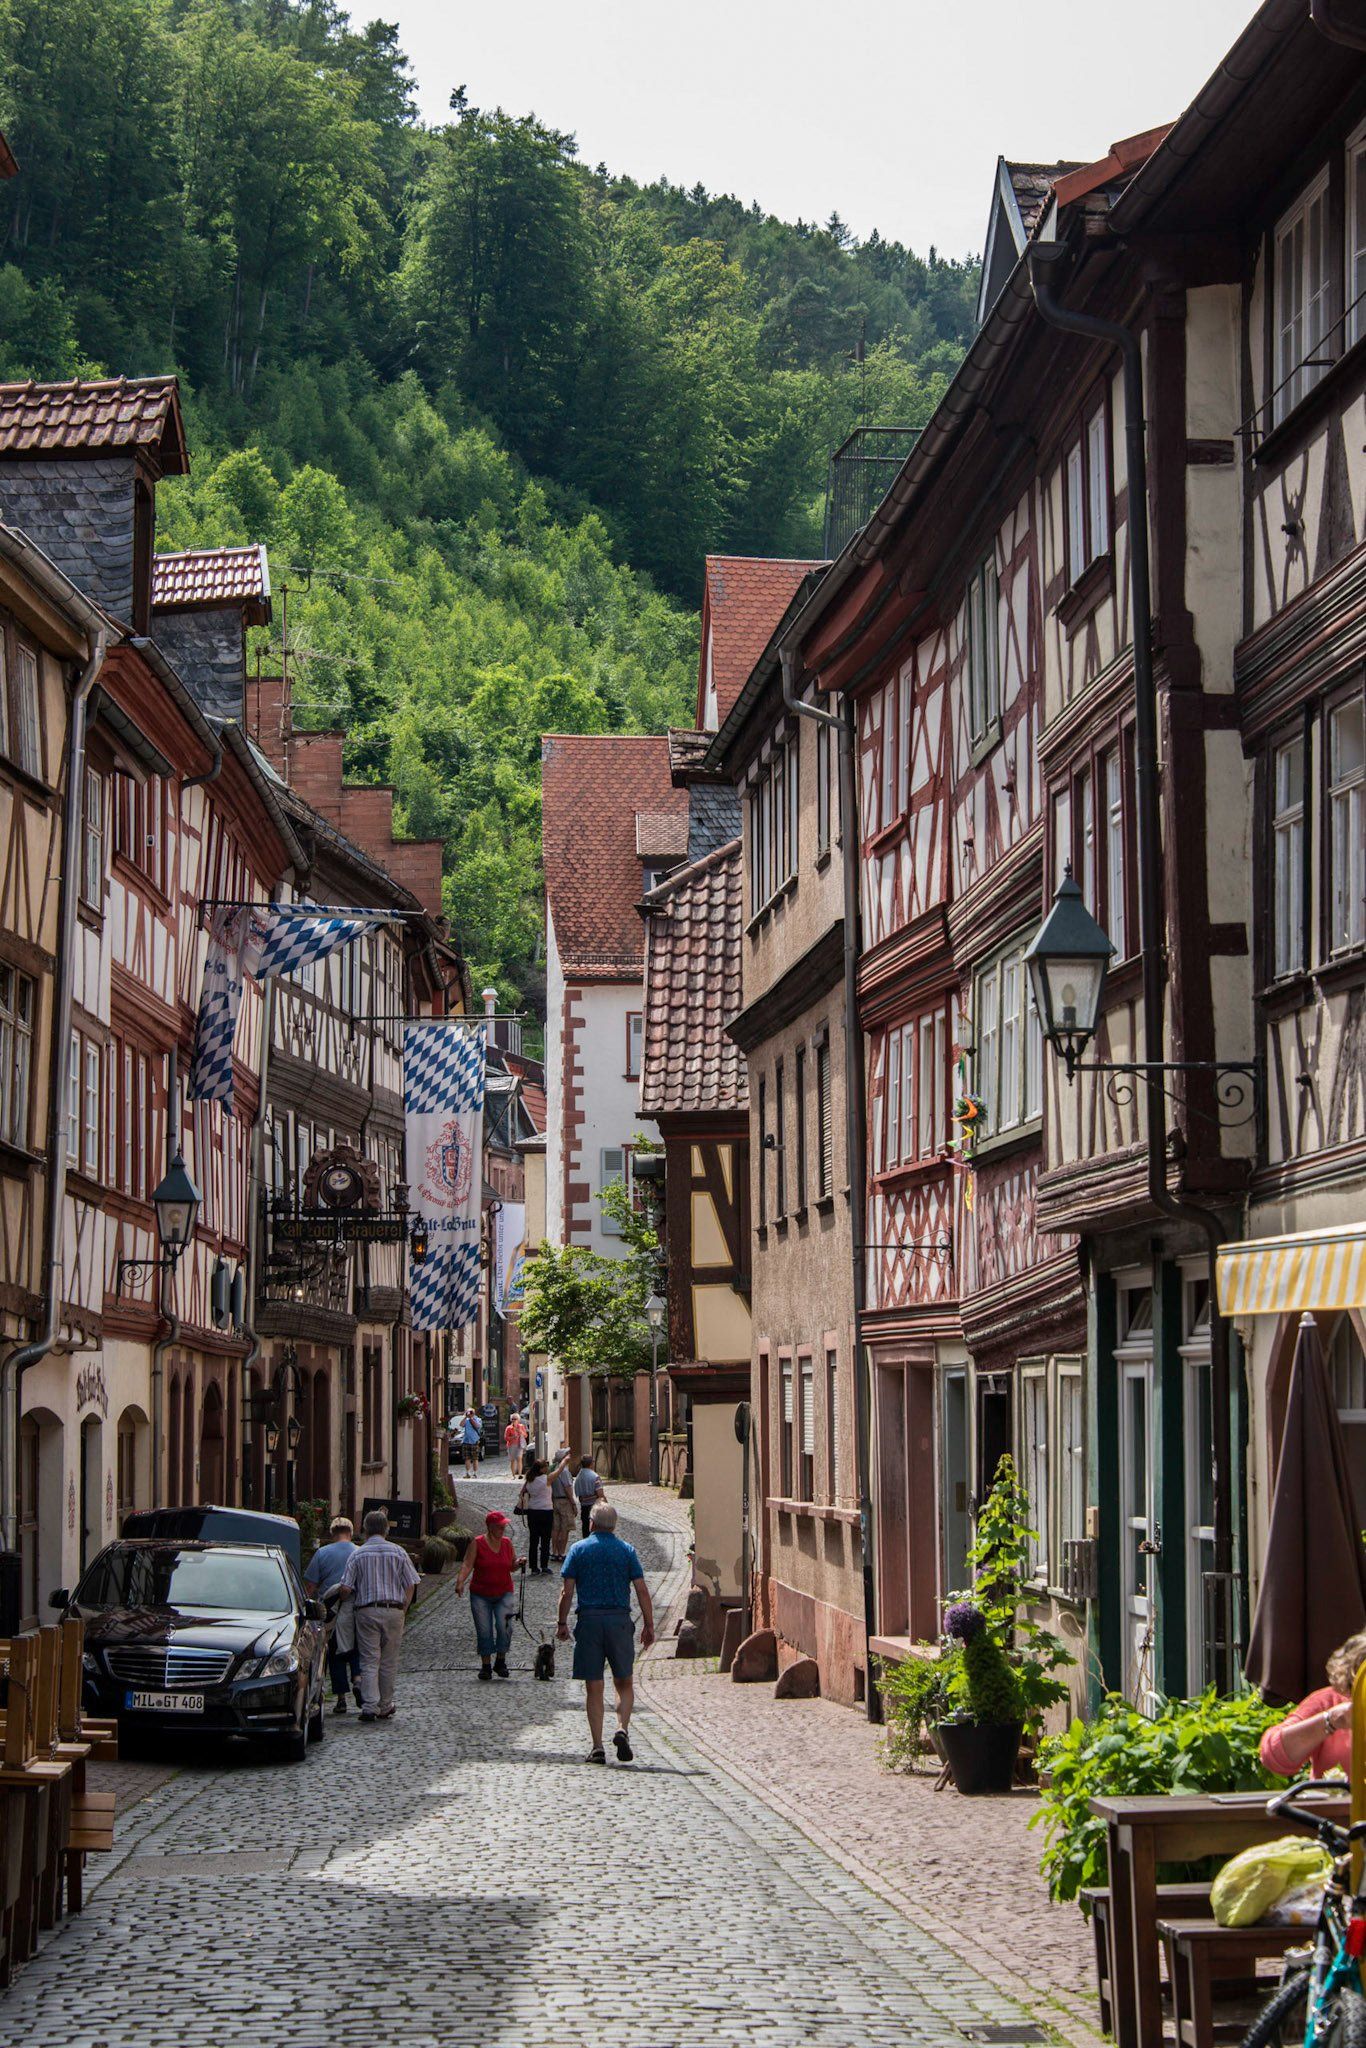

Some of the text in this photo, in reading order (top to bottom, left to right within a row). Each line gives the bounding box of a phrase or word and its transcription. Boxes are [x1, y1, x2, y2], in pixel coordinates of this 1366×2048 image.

[346, 1221, 403, 1238] Brauerei
[133, 1694, 204, 1709] MIL GT 408
